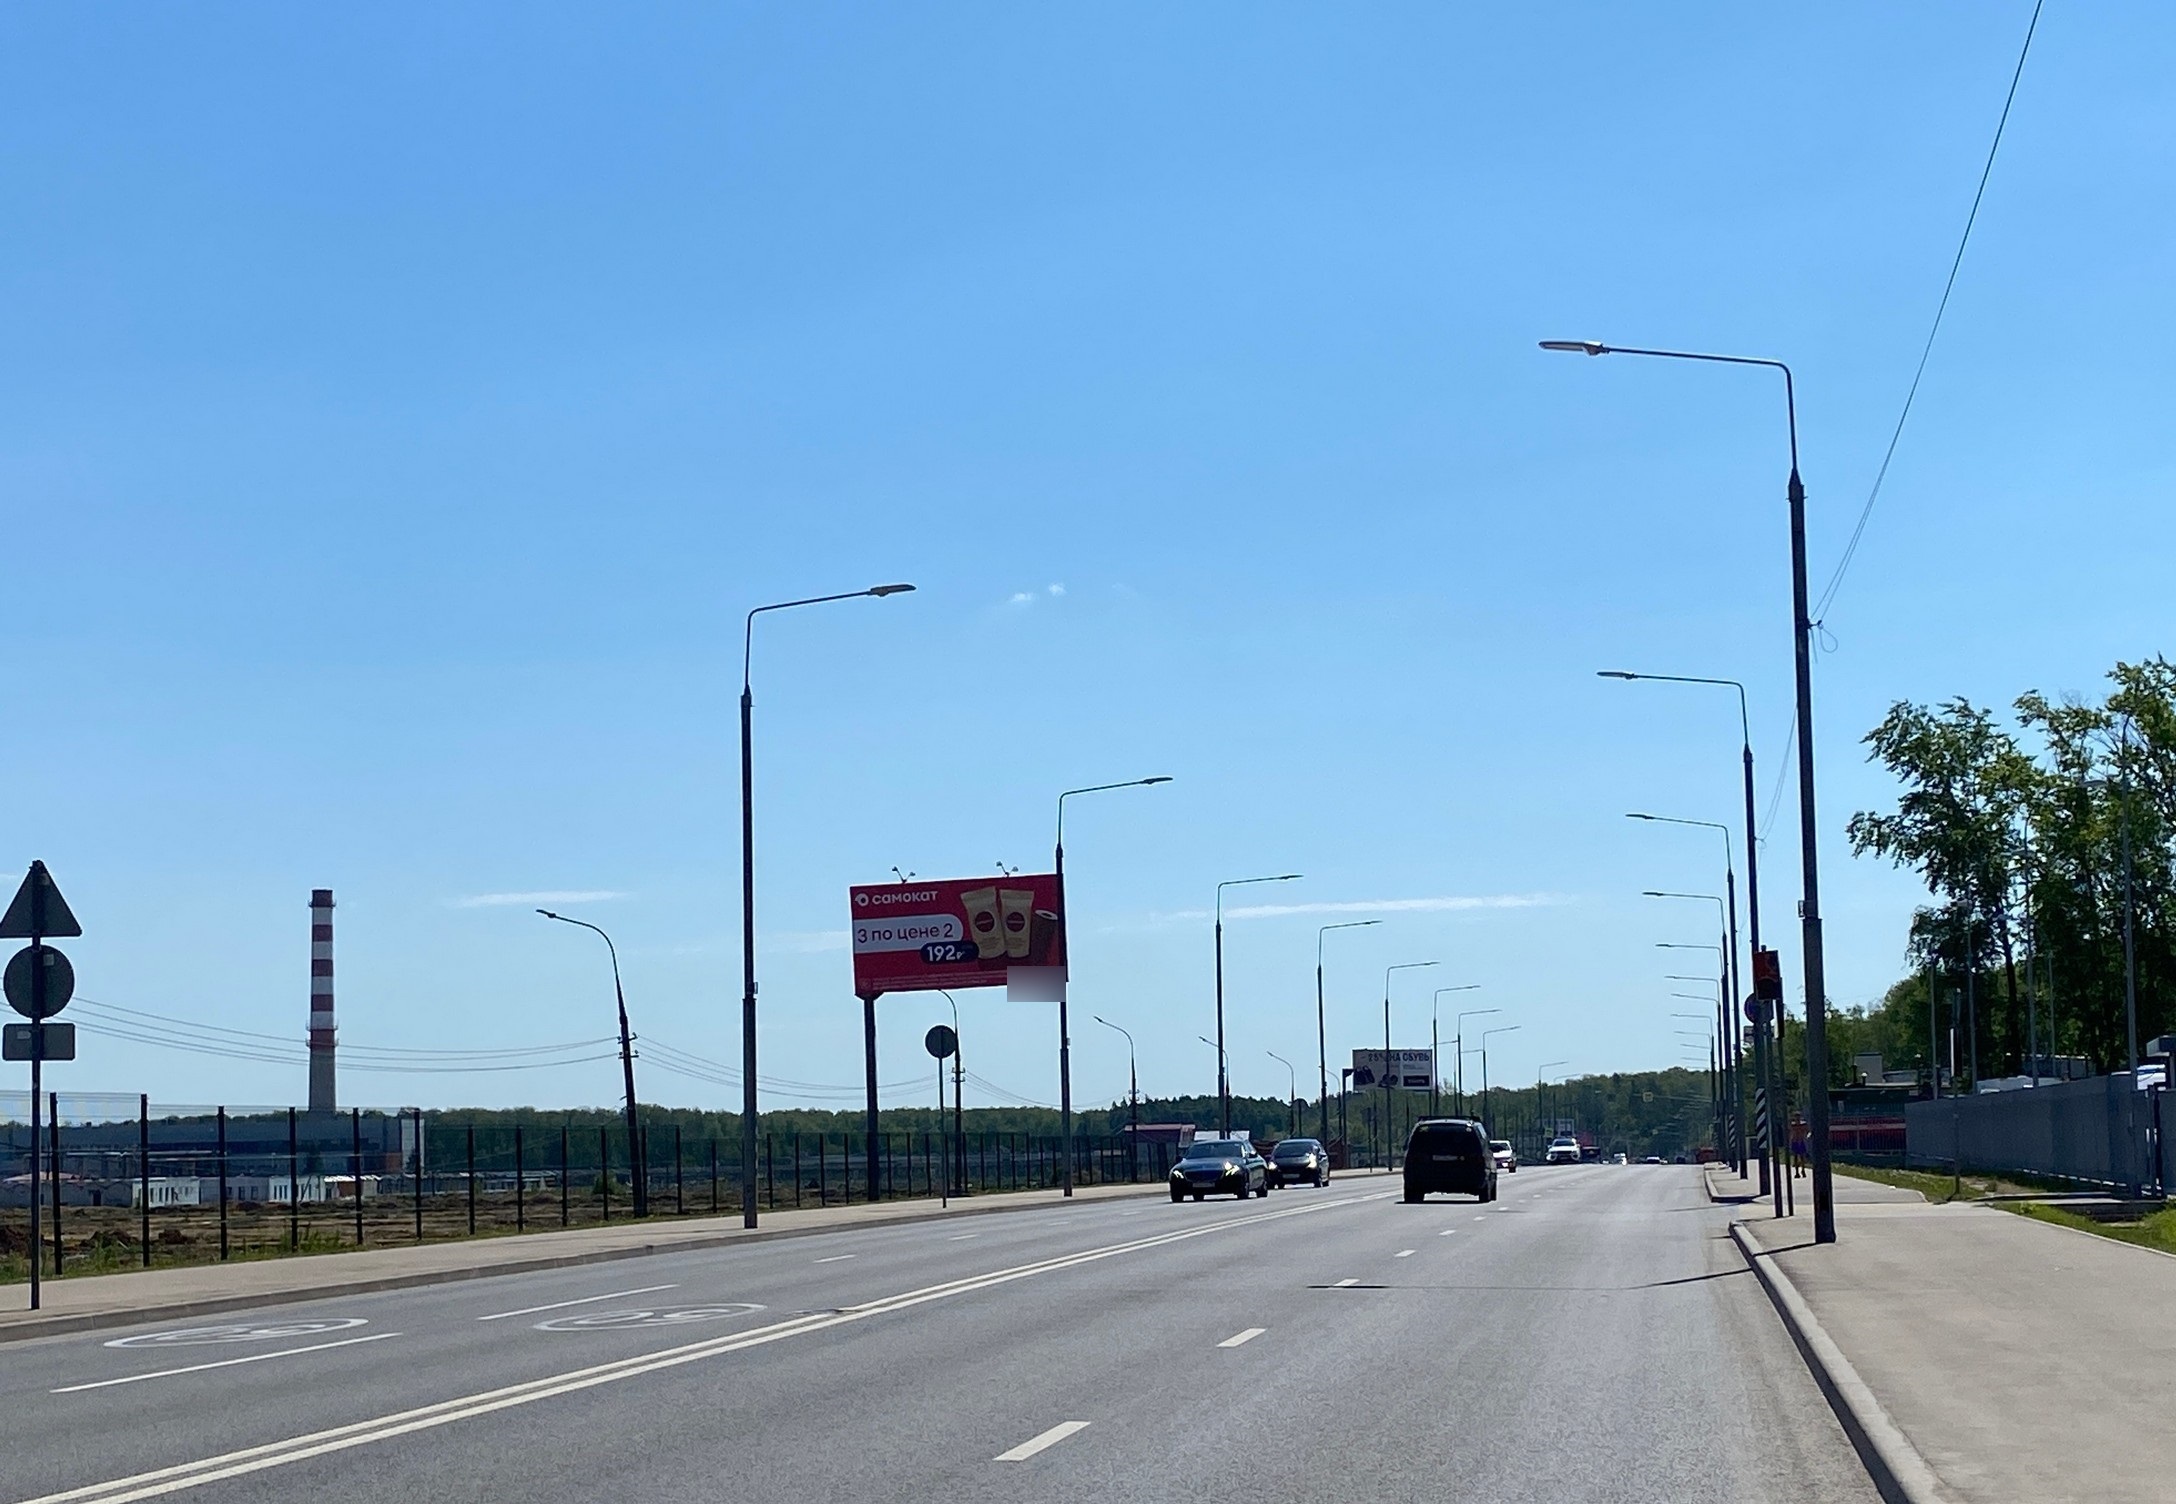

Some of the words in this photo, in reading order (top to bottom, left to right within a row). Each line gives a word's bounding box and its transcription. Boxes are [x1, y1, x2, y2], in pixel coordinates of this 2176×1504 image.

[871, 890, 938, 905] самокат
[857, 928, 868, 943] 3
[871, 930, 893, 942] по
[897, 927, 940, 941] цене
[943, 922, 954, 938] 2
